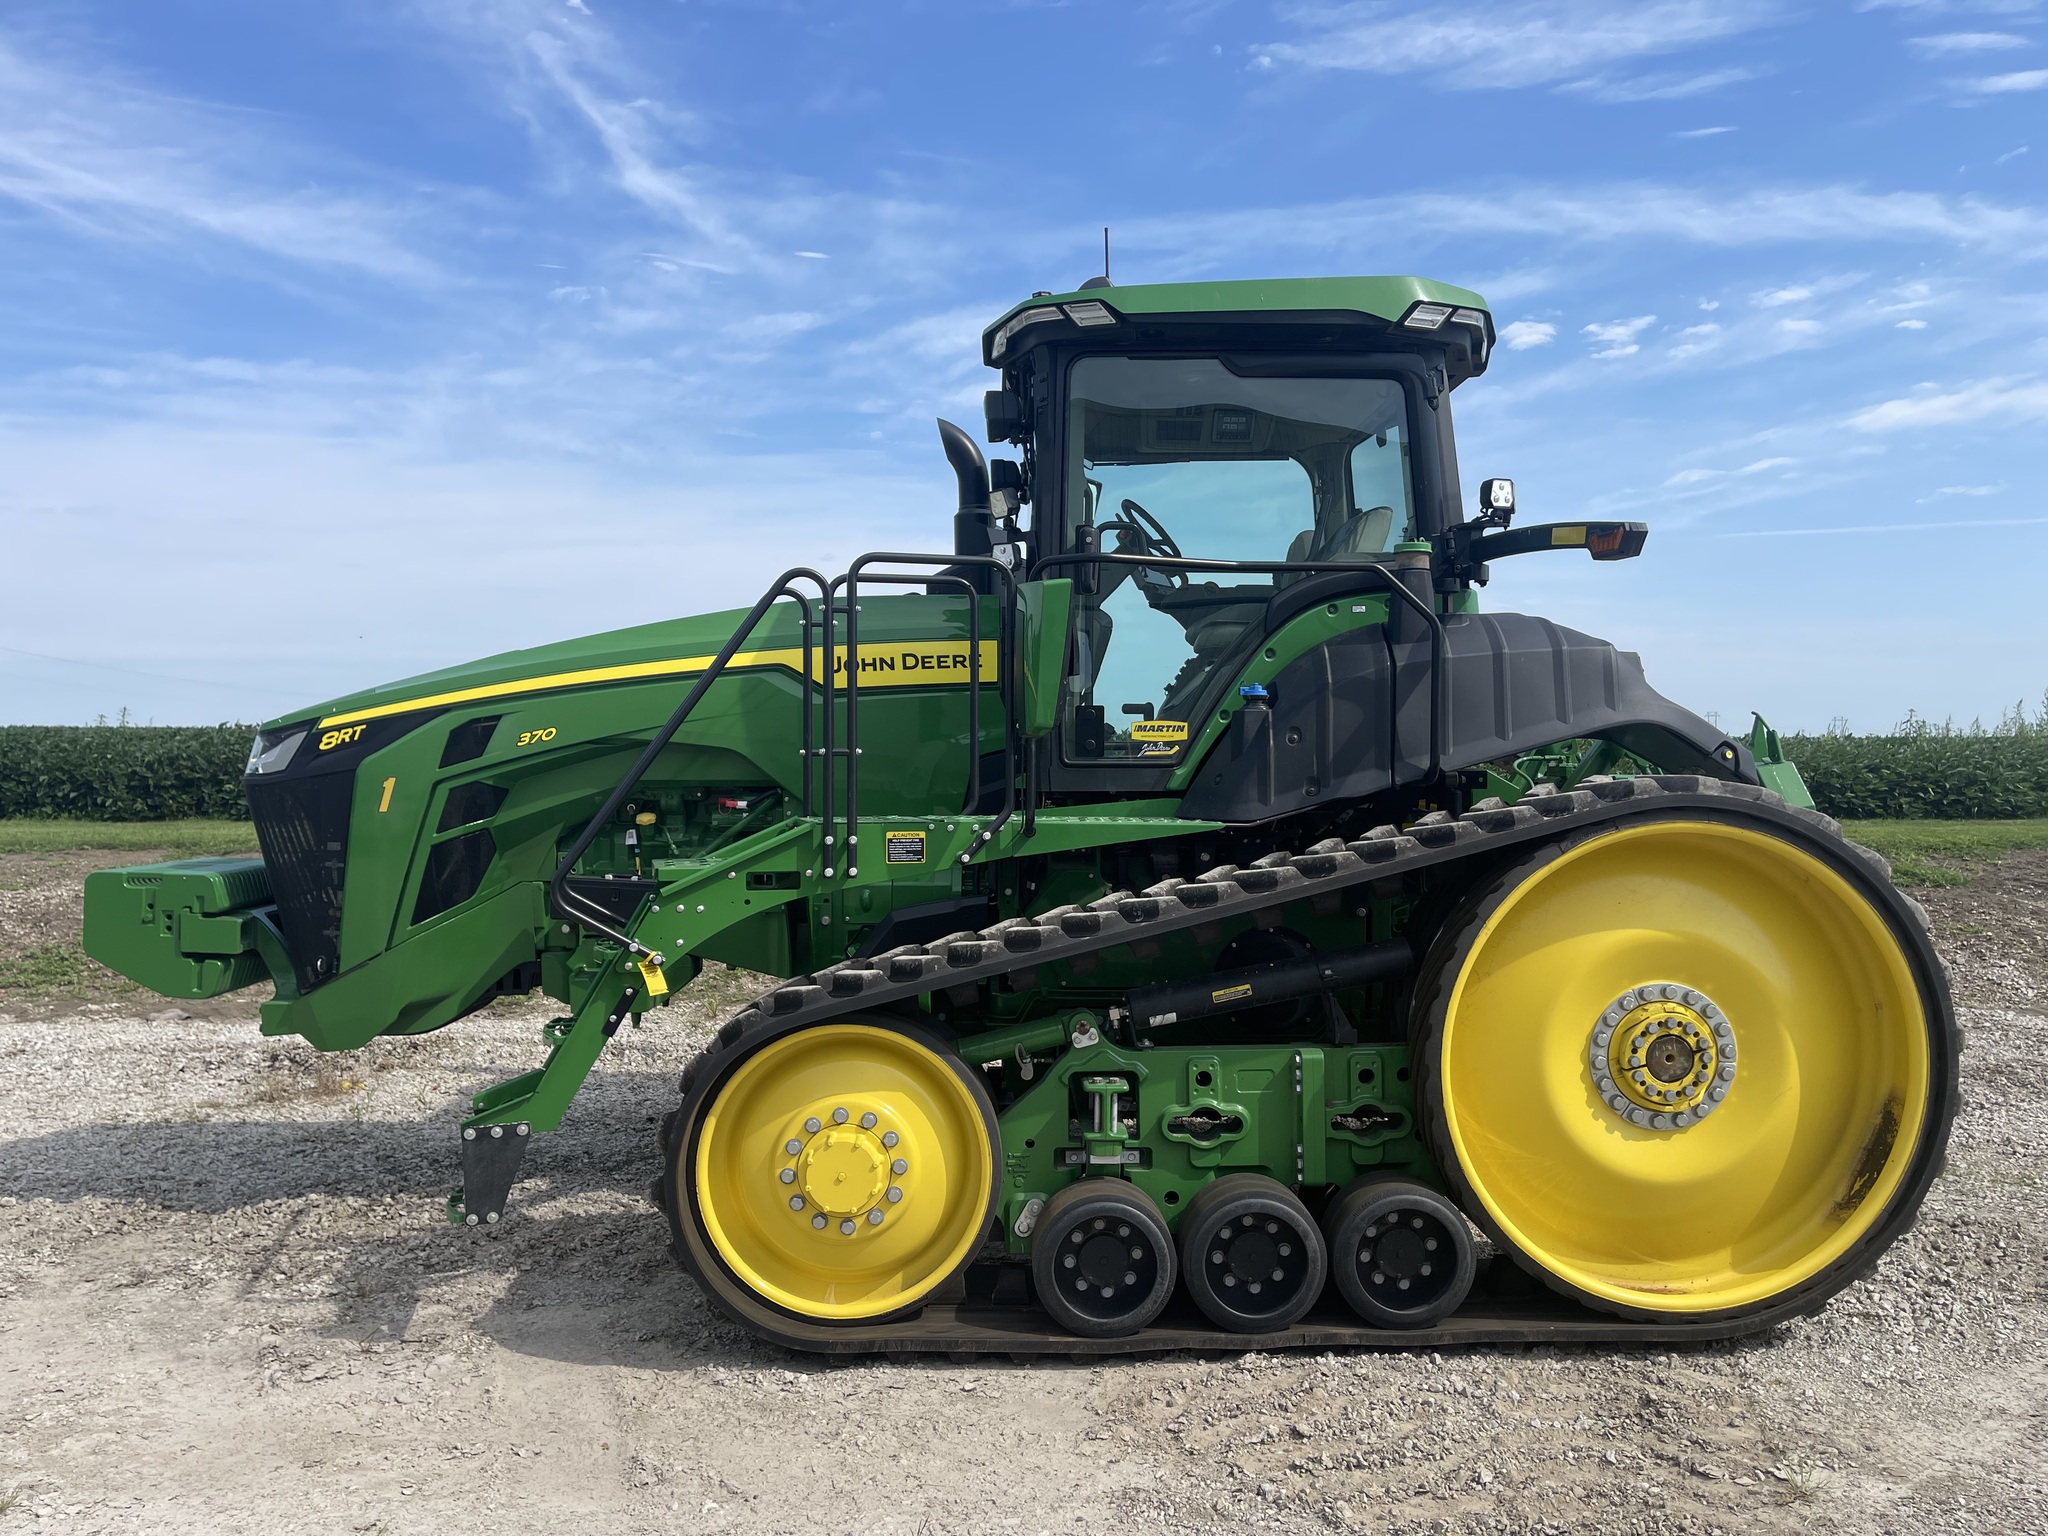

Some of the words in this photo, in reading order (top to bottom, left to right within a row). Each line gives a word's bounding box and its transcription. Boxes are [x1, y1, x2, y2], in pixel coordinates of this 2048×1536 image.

[318, 724, 367, 751] 8RT
[516, 727, 557, 747] 370
[378, 776, 397, 813] 1
